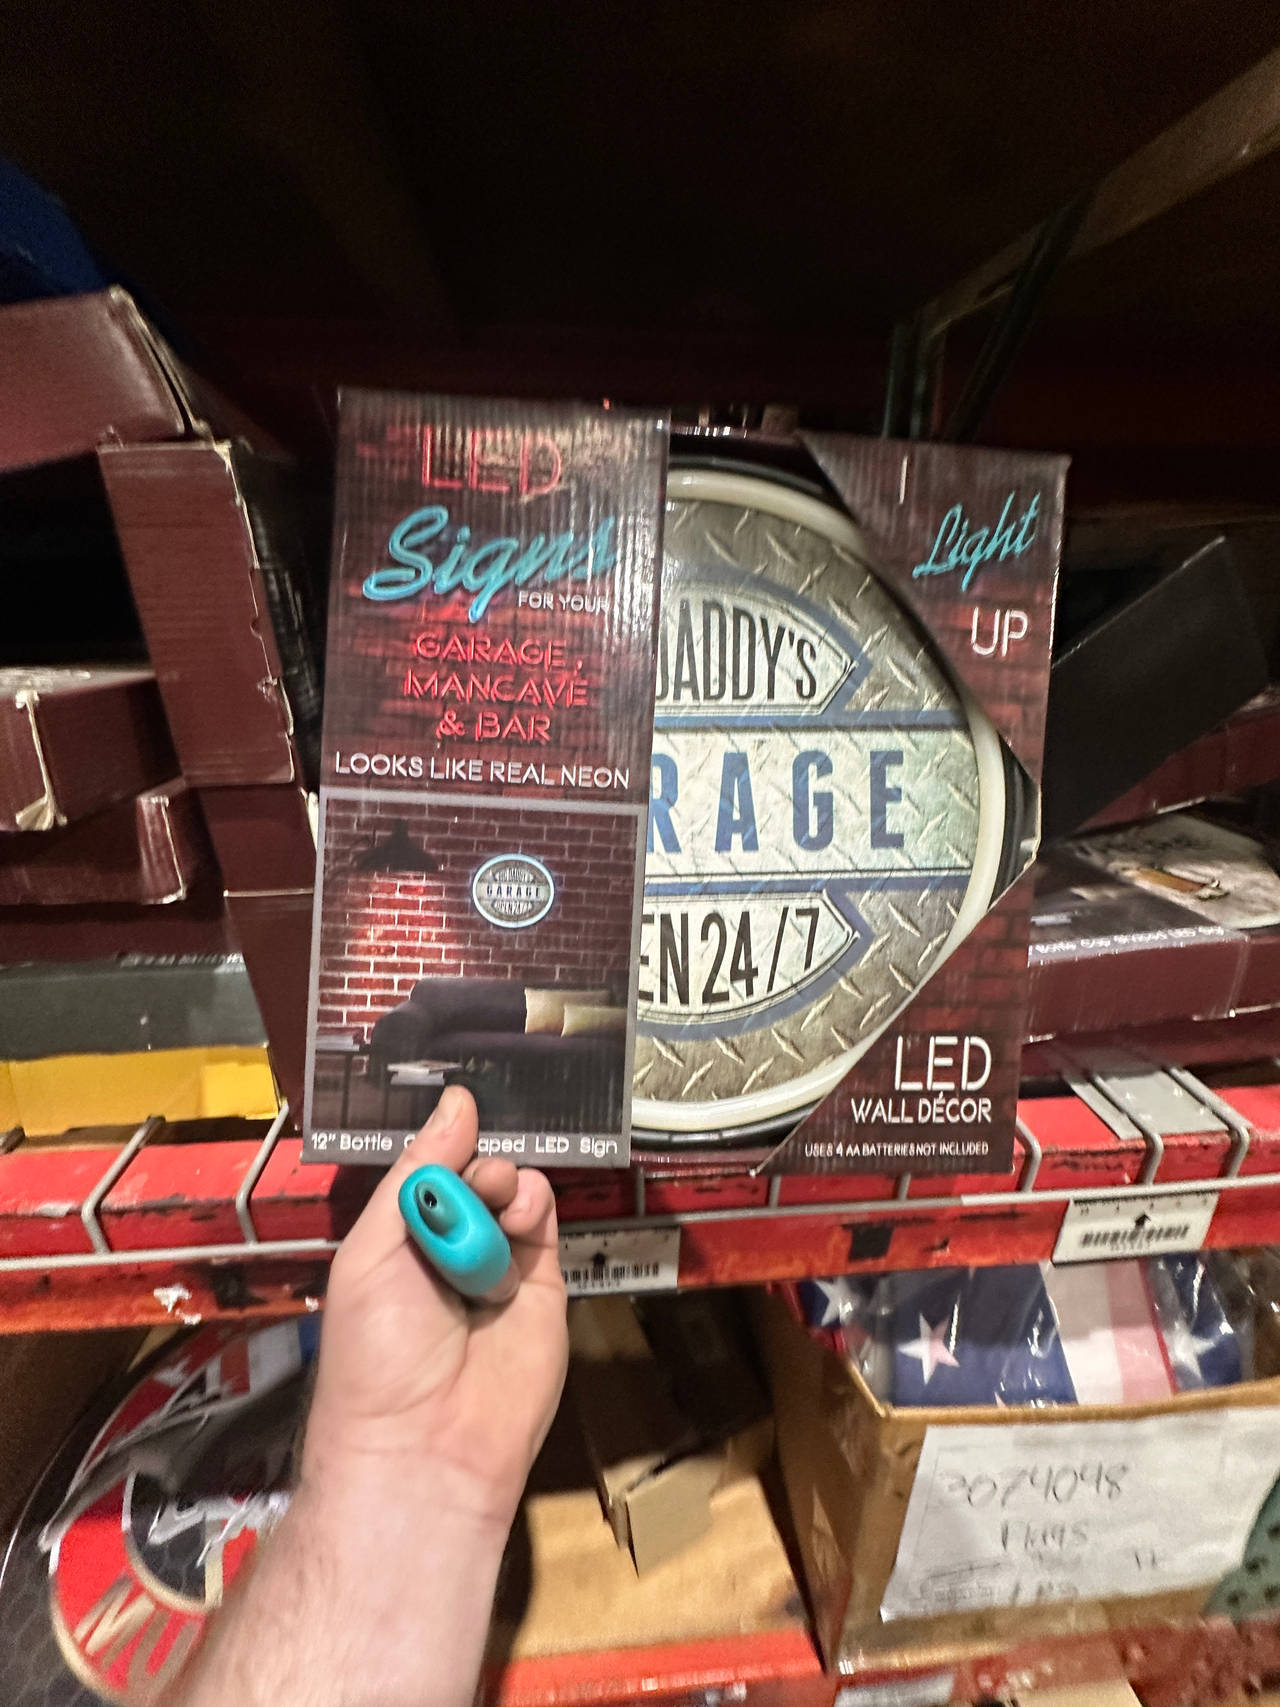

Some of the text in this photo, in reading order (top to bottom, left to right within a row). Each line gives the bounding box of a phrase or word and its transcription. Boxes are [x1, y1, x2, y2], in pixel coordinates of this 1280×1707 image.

[421, 423, 564, 497] LED
[362, 504, 620, 624] Signs
[912, 492, 1040, 591] Light
[518, 590, 610, 615] FOR YOUR
[970, 606, 1028, 658] UP
[404, 669, 589, 709] MANCAVE
[435, 709, 553, 745] & BAR
[335, 751, 630, 789] LOOKS LIKE REAL NEON
[645, 750, 905, 853] RAGE
[700, 906, 820, 1003] 24/7
[893, 1036, 993, 1091] LED
[850, 1091, 992, 1124] WALL DÉCOR
[340, 1132, 393, 1151] Bottle
[535, 1135, 570, 1154] LED
[579, 1136, 618, 1158] Sign
[805, 1141, 990, 1158] USES 4 AA BATTERIES NOT INCLUDED
